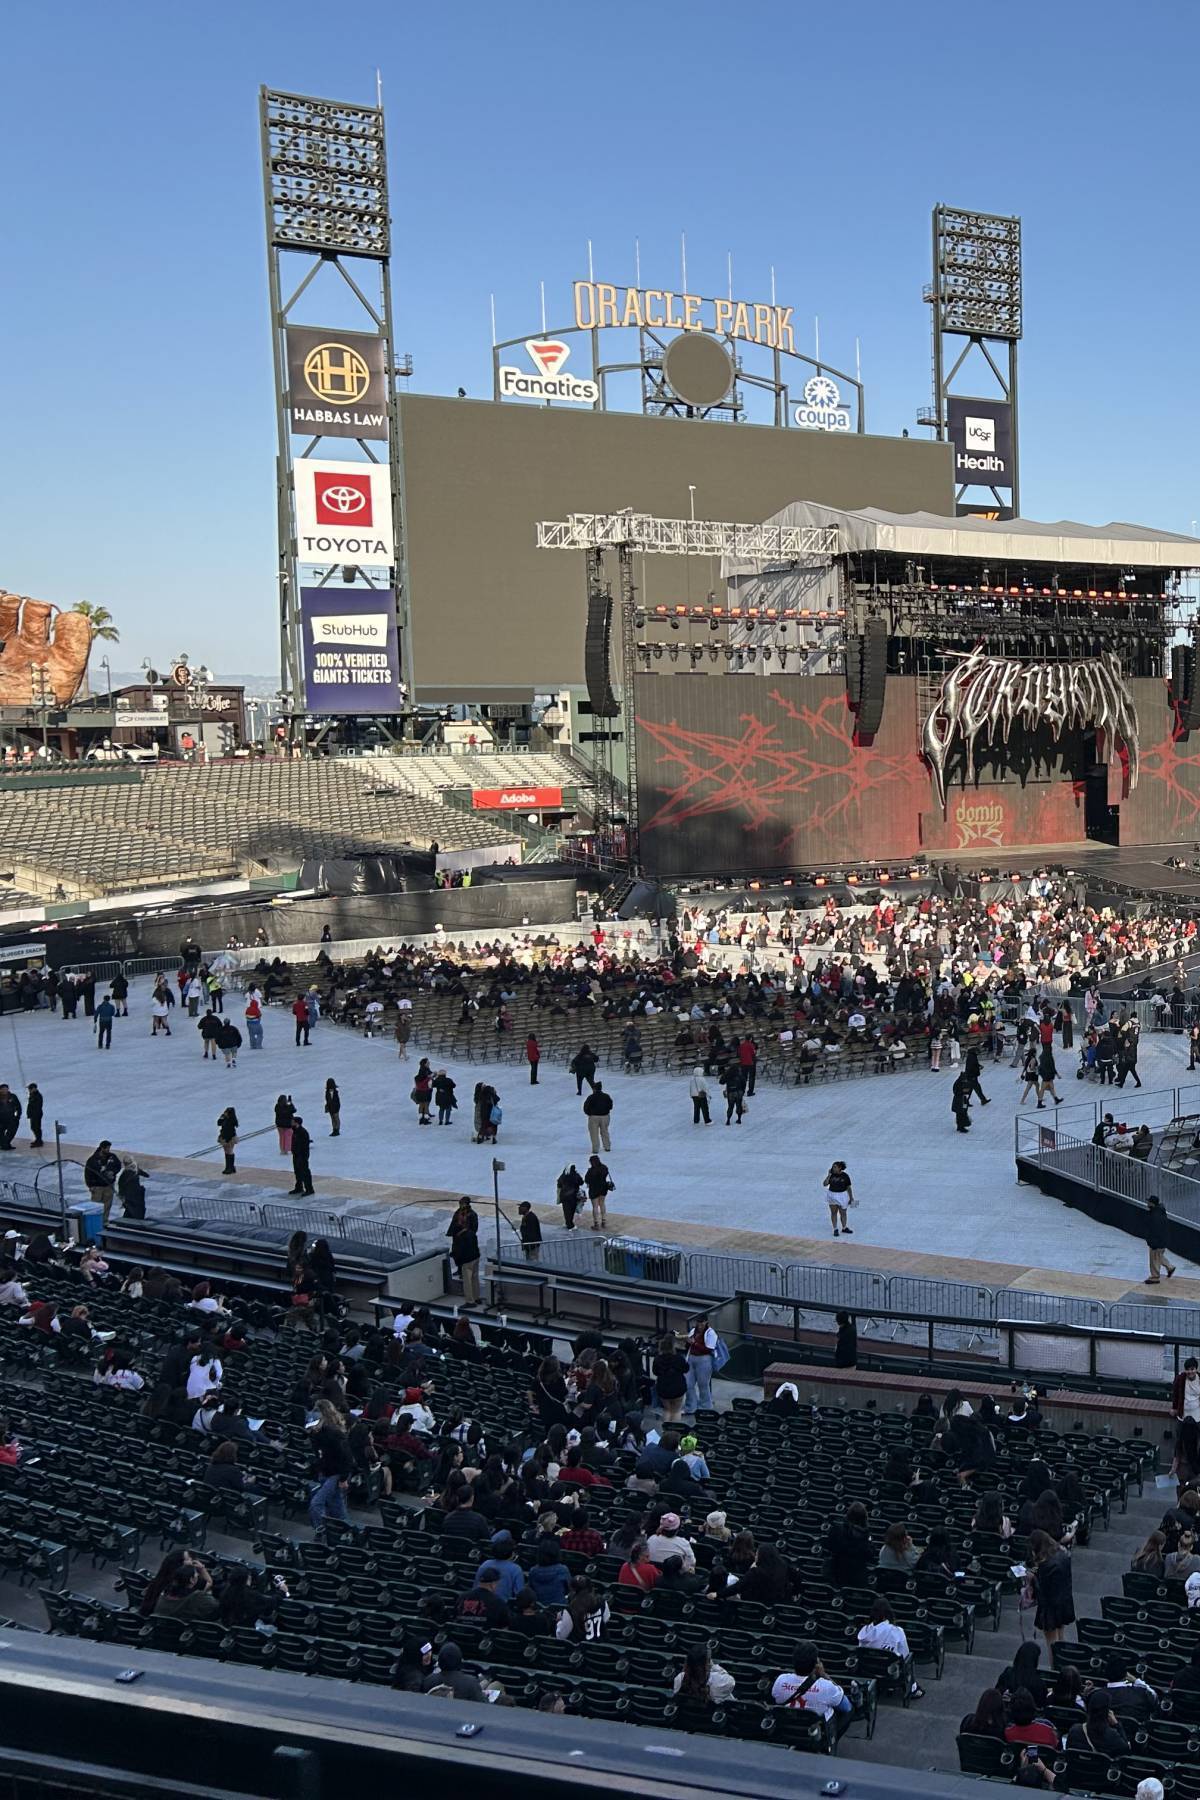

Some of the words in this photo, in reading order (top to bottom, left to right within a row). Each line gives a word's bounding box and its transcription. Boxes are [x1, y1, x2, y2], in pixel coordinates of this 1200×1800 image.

[574, 281, 703, 332] ORACLE
[713, 297, 796, 354] PARK
[503, 371, 596, 400] Fanatics
[294, 408, 352, 427] HABBAS
[354, 412, 384, 428] LAW
[798, 410, 848, 431] coupa
[969, 427, 991, 442] UCSF
[957, 453, 1005, 472] Health
[303, 536, 388, 555] TOYOTA
[322, 623, 378, 637] StubHub
[315, 652, 343, 668] 100%
[344, 653, 388, 669] VERIFIED
[313, 668, 349, 684] GIANTS
[351, 669, 392, 685] TICKETS
[207, 694, 231, 712] Coffee
[500, 793, 536, 804] Adobe
[584, 1616, 602, 1640] 97
